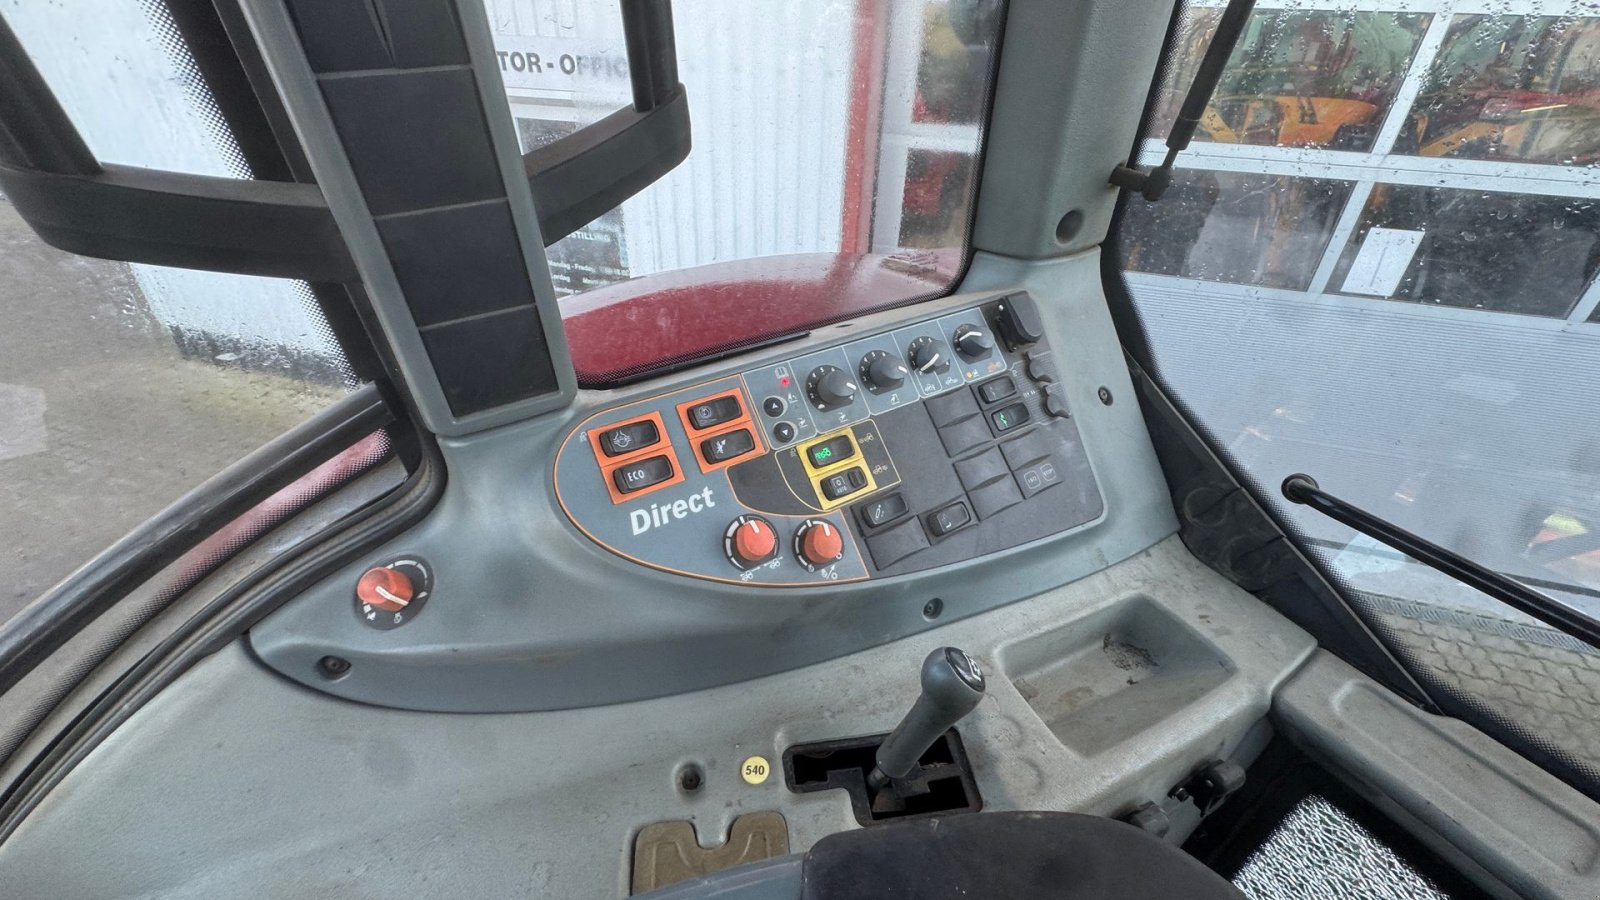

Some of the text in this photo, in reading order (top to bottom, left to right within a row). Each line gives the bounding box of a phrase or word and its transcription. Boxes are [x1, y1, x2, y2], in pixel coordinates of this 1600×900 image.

[627, 469, 645, 482] ECO
[629, 485, 716, 536] Direct
[745, 765, 765, 776] 540
